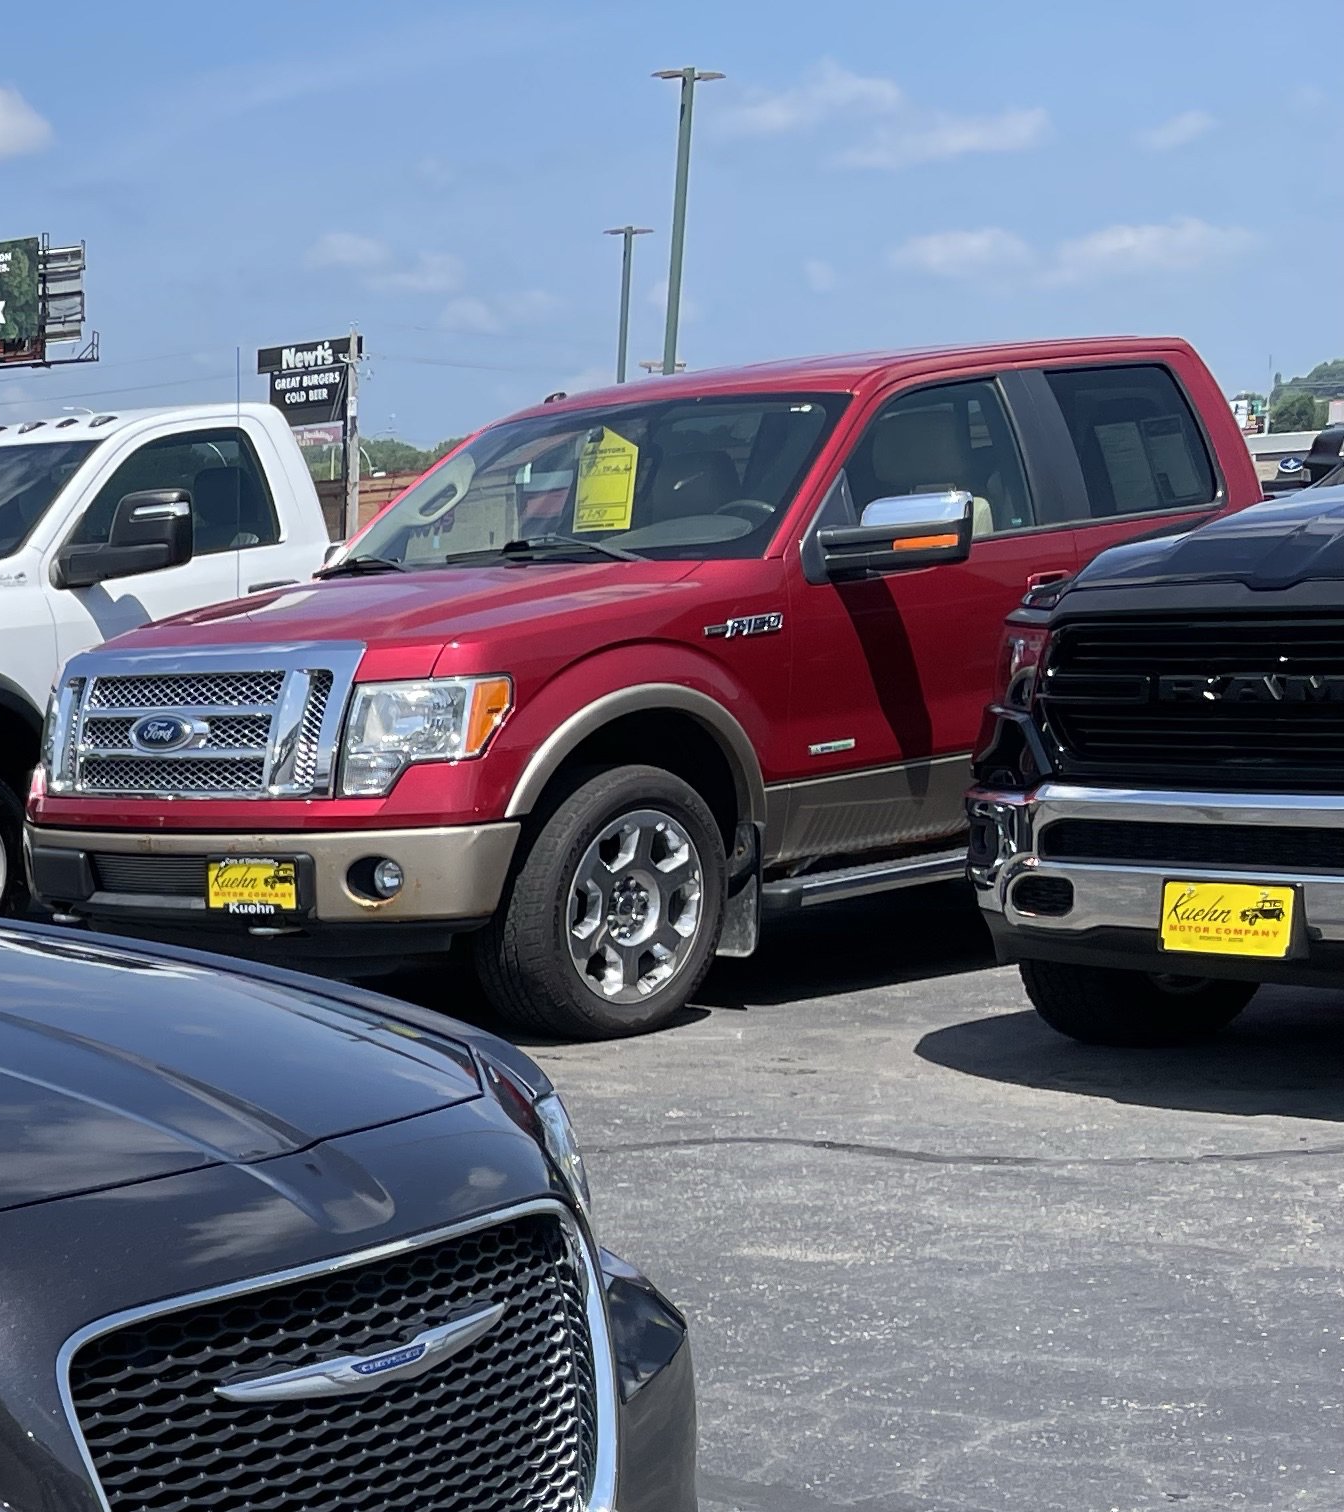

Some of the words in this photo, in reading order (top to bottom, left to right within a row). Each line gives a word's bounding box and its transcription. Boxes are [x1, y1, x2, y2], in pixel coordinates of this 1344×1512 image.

[281, 340, 333, 370] Newt's
[274, 376, 300, 390] GREAT
[302, 371, 340, 387] BURGERS
[284, 390, 306, 404] COLD
[308, 388, 328, 401] BEER
[143, 721, 174, 742] Ford
[211, 863, 258, 891] Kuehn
[228, 901, 275, 915] Kuehn
[1167, 892, 1232, 924] Kuehn
[1168, 924, 1210, 935] MOTOR
[1215, 927, 1280, 938] COMPANY
[361, 1348, 420, 1372] CHRYSLER
